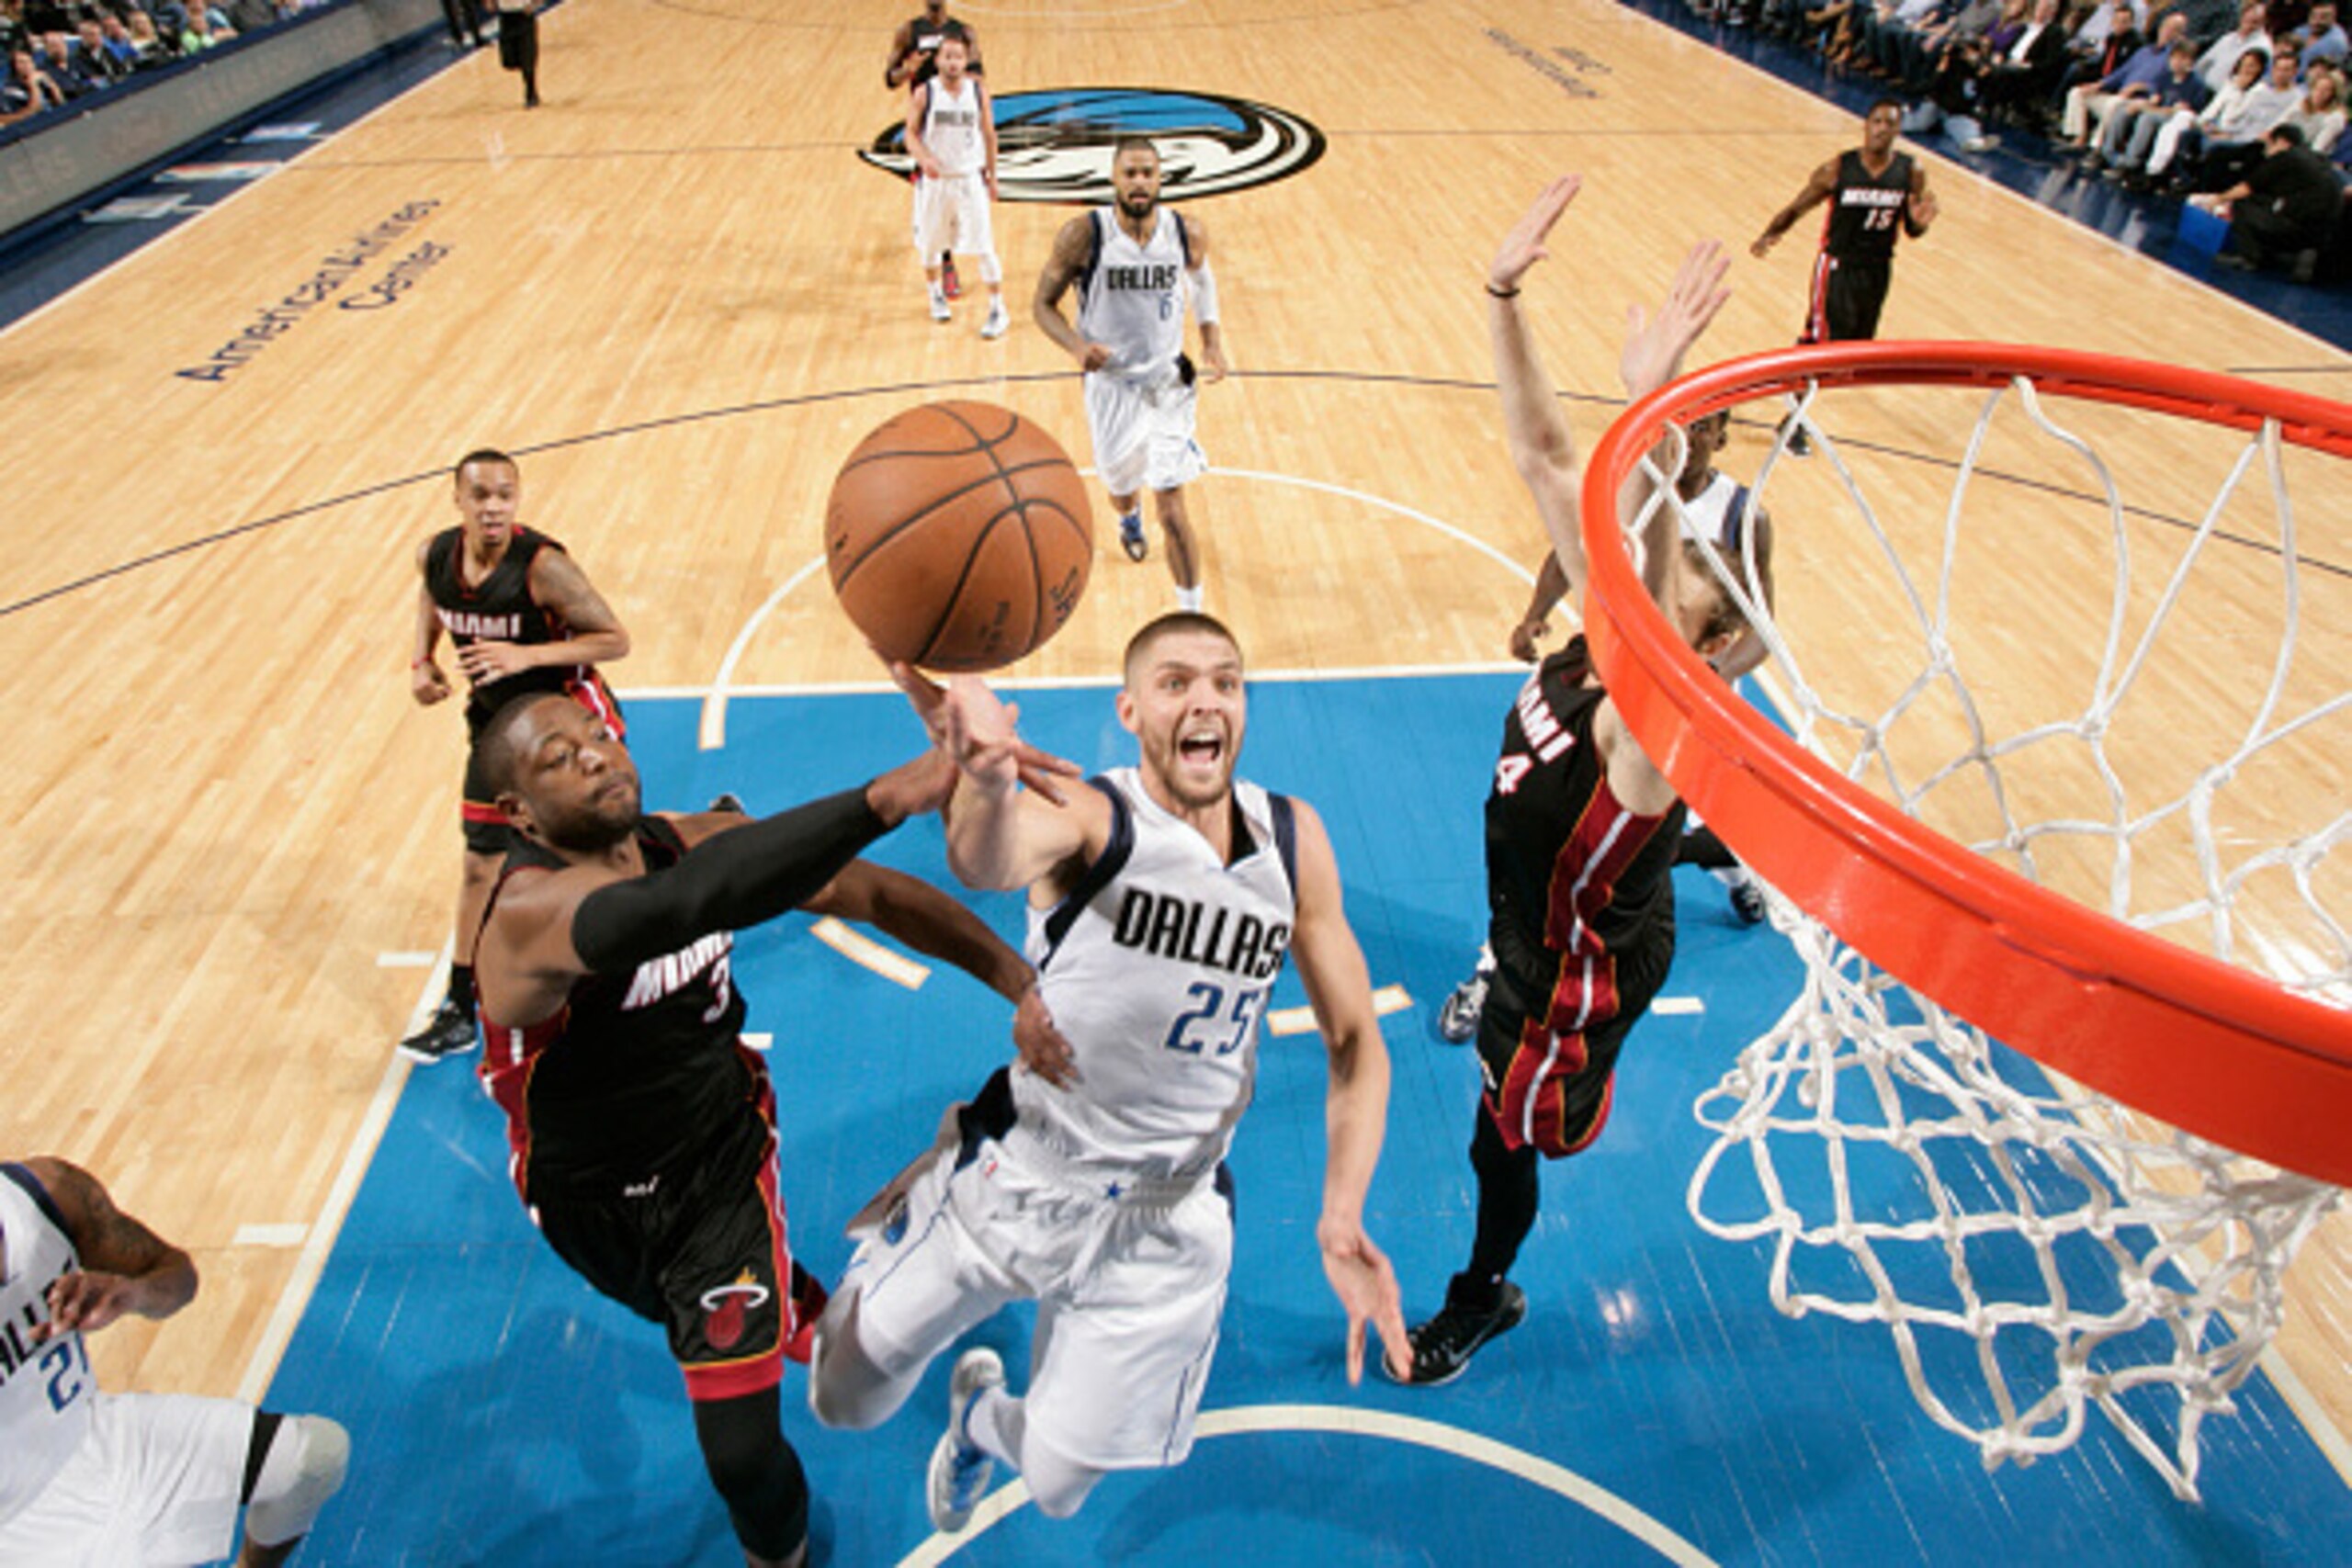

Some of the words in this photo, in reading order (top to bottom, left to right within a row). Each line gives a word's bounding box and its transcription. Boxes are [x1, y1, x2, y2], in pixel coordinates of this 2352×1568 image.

[1863, 208, 1895, 231] 15
[1108, 264, 1177, 290] DALLAS
[1159, 292, 1173, 321] 6
[174, 268, 358, 381] American
[1517, 672, 1577, 764] AMI
[1497, 751, 1533, 795] 4
[1112, 886, 1289, 980] DALLAS
[703, 955, 731, 1023] 3
[1165, 980, 1261, 1056] 25
